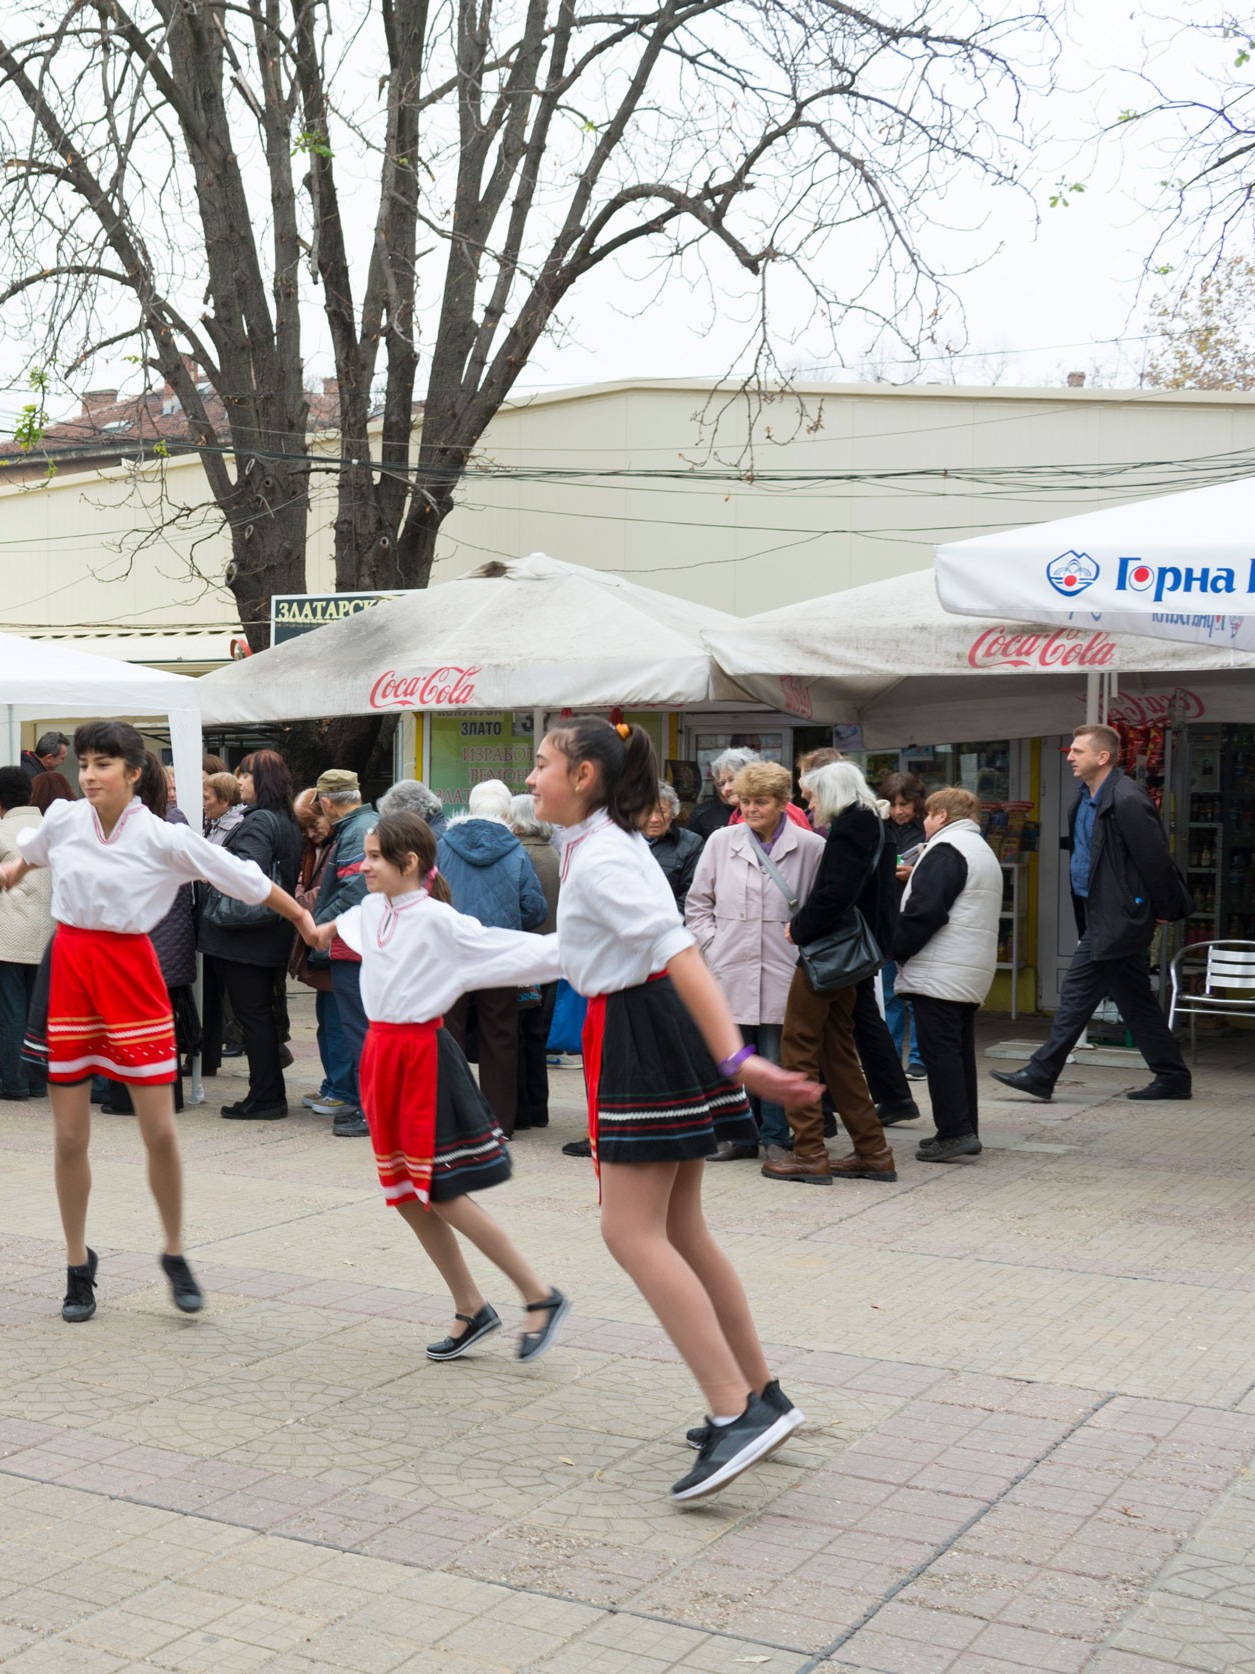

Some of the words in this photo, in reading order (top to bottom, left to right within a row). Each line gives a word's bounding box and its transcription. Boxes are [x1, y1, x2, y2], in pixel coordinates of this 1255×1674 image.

[1114, 556, 1238, 602] Горна
[278, 599, 391, 621] ЗЛАТАРСК
[968, 625, 1116, 669] Coca-Cola
[369, 665, 482, 708] Coca-Cola
[460, 721, 502, 736] ЗЛАТО
[461, 747, 534, 762] ИЗРАБОТ
[469, 767, 533, 784] РЕМОН
